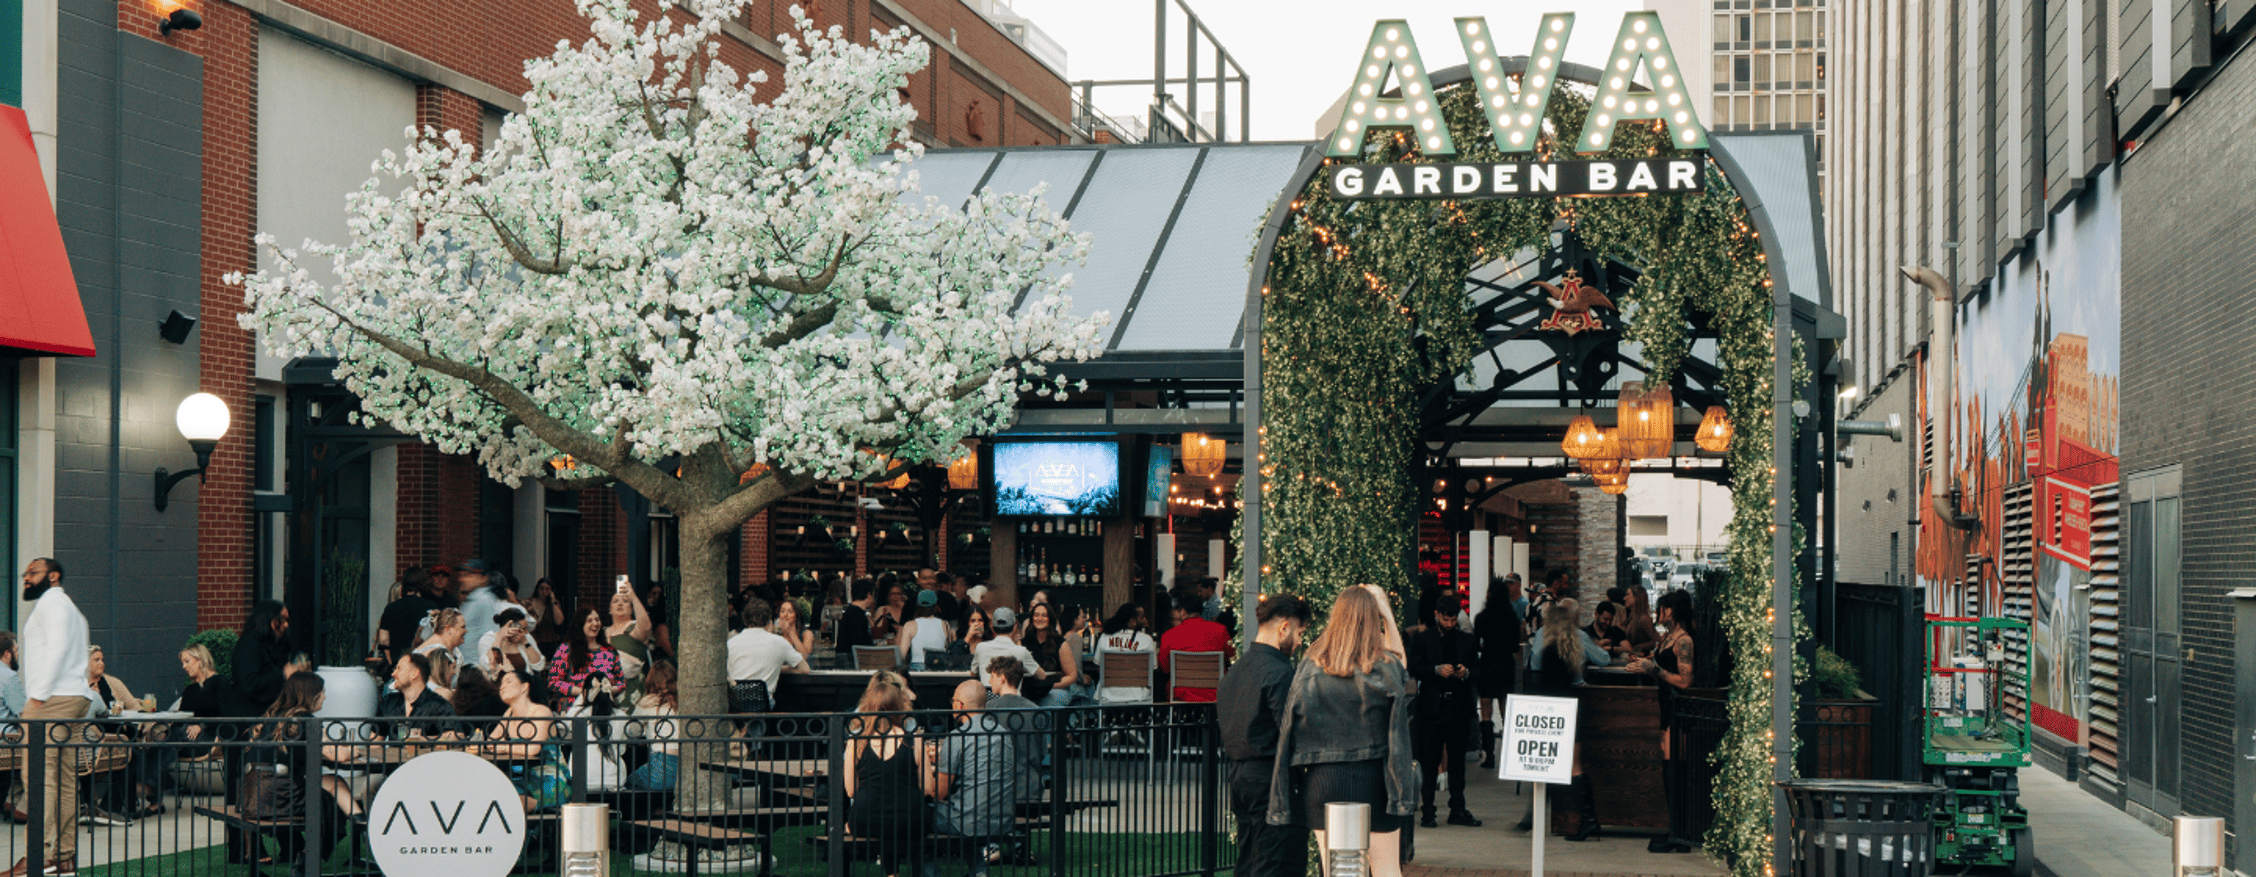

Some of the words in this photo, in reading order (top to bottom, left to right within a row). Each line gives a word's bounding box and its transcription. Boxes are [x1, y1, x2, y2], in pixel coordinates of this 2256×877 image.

[1326, 10, 1710, 157] AVA
[1335, 163, 1557, 196] GARDEN
[1589, 160, 1697, 192] BAR
[1516, 714, 1565, 729] CLOSED
[1518, 740, 1558, 757] OPEN
[382, 800, 512, 835] AVA
[399, 846, 458, 855] GARDEN
[464, 845, 493, 854] BAR
